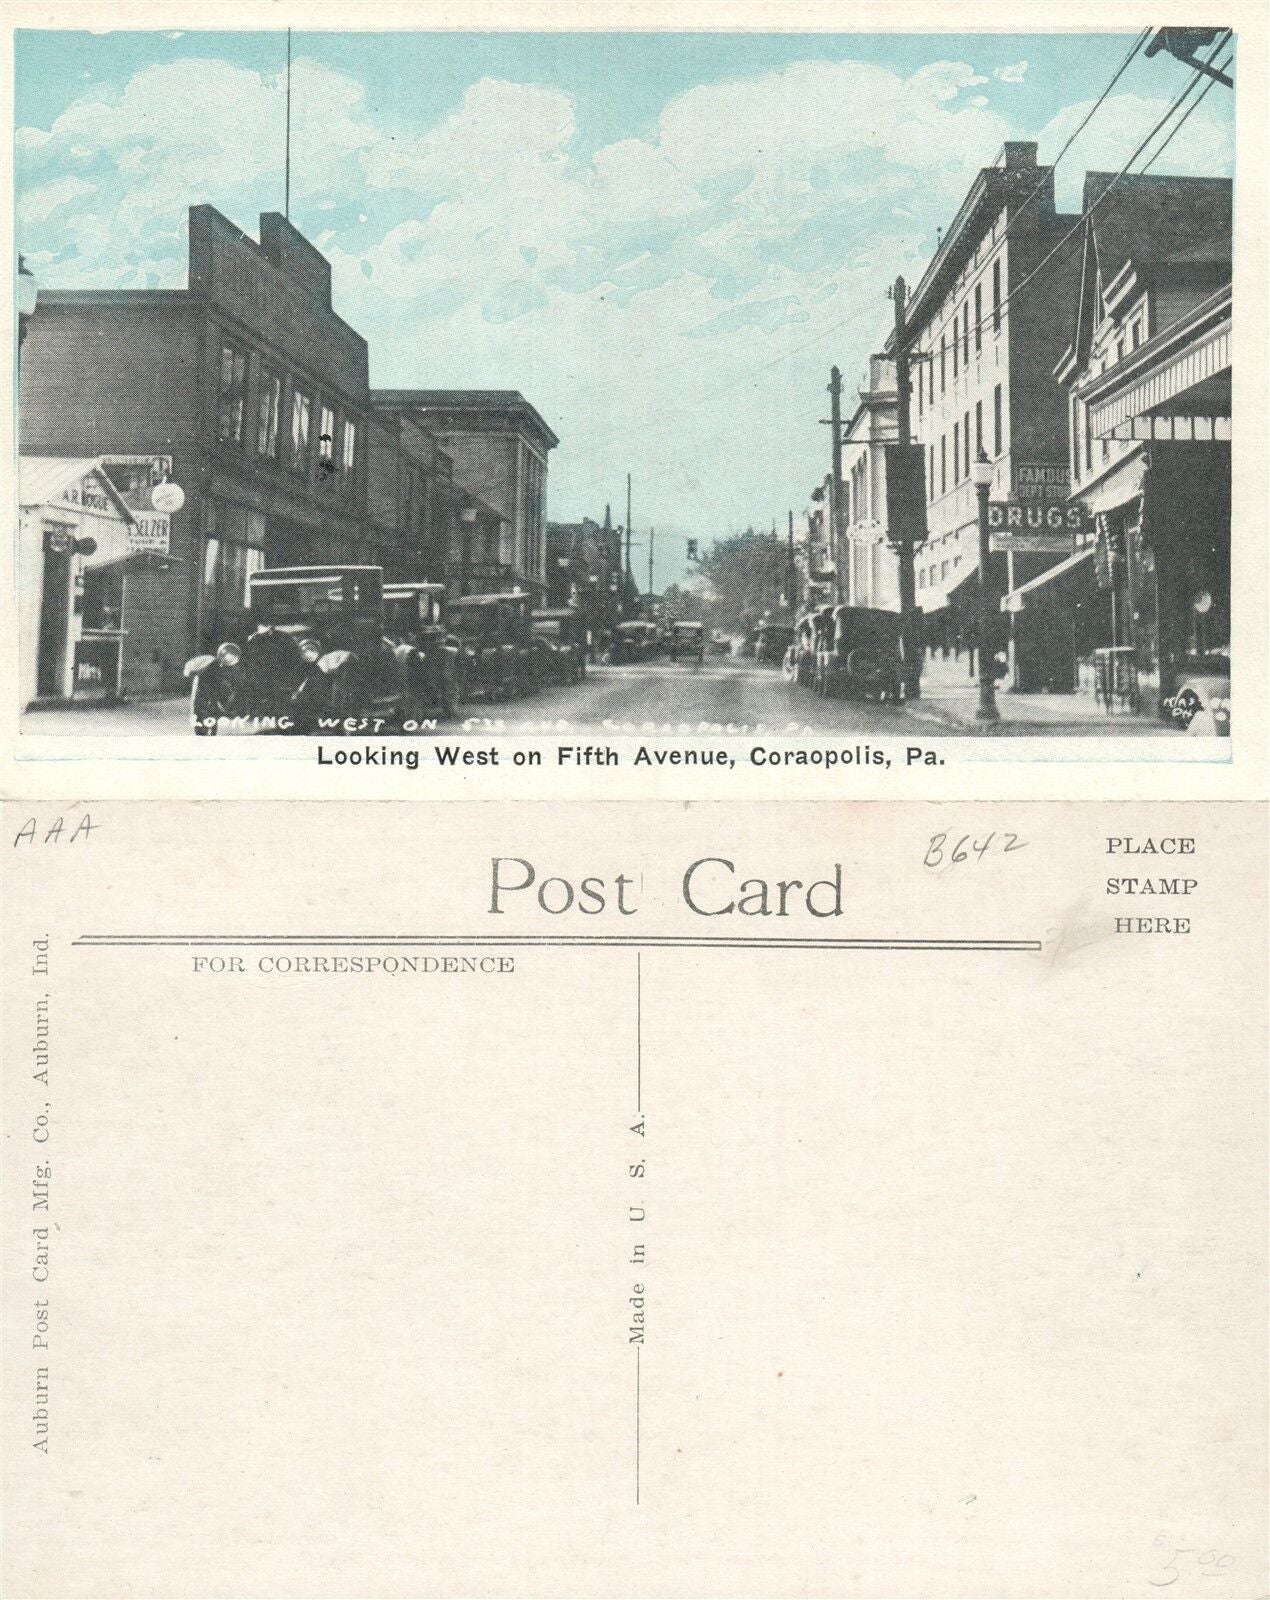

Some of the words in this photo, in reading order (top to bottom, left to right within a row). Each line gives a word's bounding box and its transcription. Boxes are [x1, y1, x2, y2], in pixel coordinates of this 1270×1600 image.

[1019, 467, 1072, 484] FAMOUS
[988, 505, 1082, 529] DRUGS
[190, 713, 295, 729] LOOKING
[317, 717, 386, 733] WEST
[402, 717, 439, 731] ON
[318, 746, 419, 770] Looking
[434, 747, 499, 766] West
[513, 751, 541, 766] on
[558, 746, 619, 766] Fifth
[634, 747, 735, 769] Avenue,
[750, 745, 891, 769] Coraopolis,
[907, 747, 945, 766] Pa.
[924, 832, 1028, 868] B642
[1106, 838, 1195, 855] PLACE
[488, 858, 638, 915] Post
[682, 858, 844, 917] Card
[1106, 878, 1198, 895] STAMP
[1114, 917, 1191, 934] HERE
[32, 932, 49, 976] Ind.
[192, 957, 246, 973] FOR
[258, 956, 515, 974] CORRESPONDENCE
[32, 994, 51, 1086] Auburn,
[32, 1102, 51, 1144] Co.,
[629, 1114, 645, 1138] A.
[629, 1159, 646, 1178] S.
[32, 1160, 51, 1211] Mfg.
[32, 1227, 49, 1283] Card
[629, 1244, 645, 1264] in
[32, 1300, 49, 1350] Post
[629, 1283, 645, 1345] Made
[32, 1367, 49, 1455] Auburn
